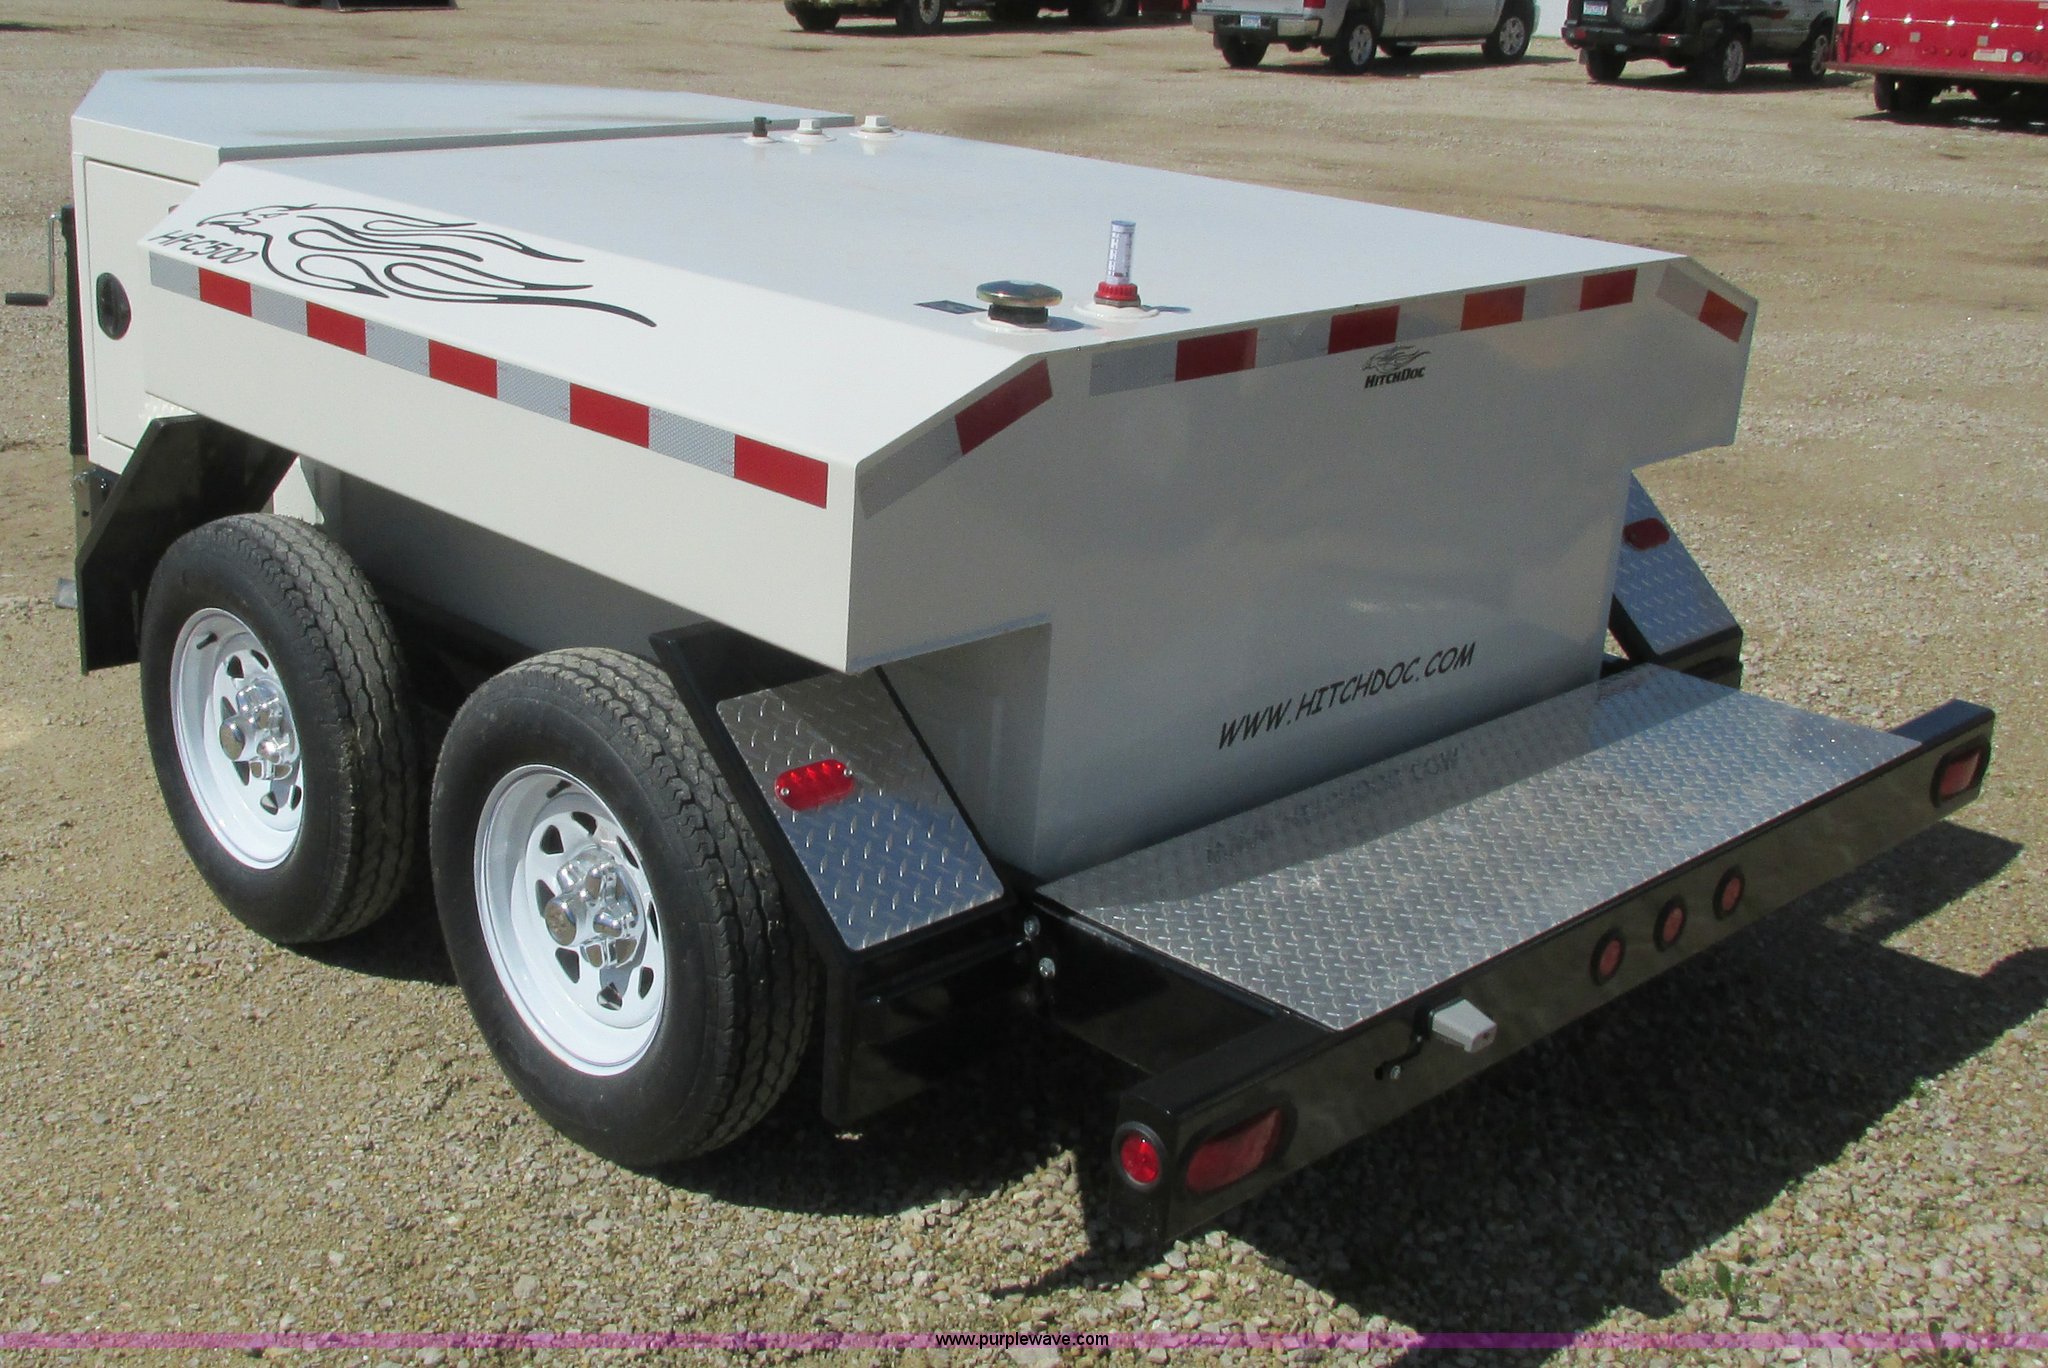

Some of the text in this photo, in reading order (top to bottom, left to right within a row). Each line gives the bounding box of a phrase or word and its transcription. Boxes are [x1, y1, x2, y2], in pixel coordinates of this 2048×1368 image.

[146, 229, 260, 264] HFC500
[1363, 366, 1427, 389] HITCHDOC
[1218, 641, 1477, 750] WWW.HITCHDOC.COM
